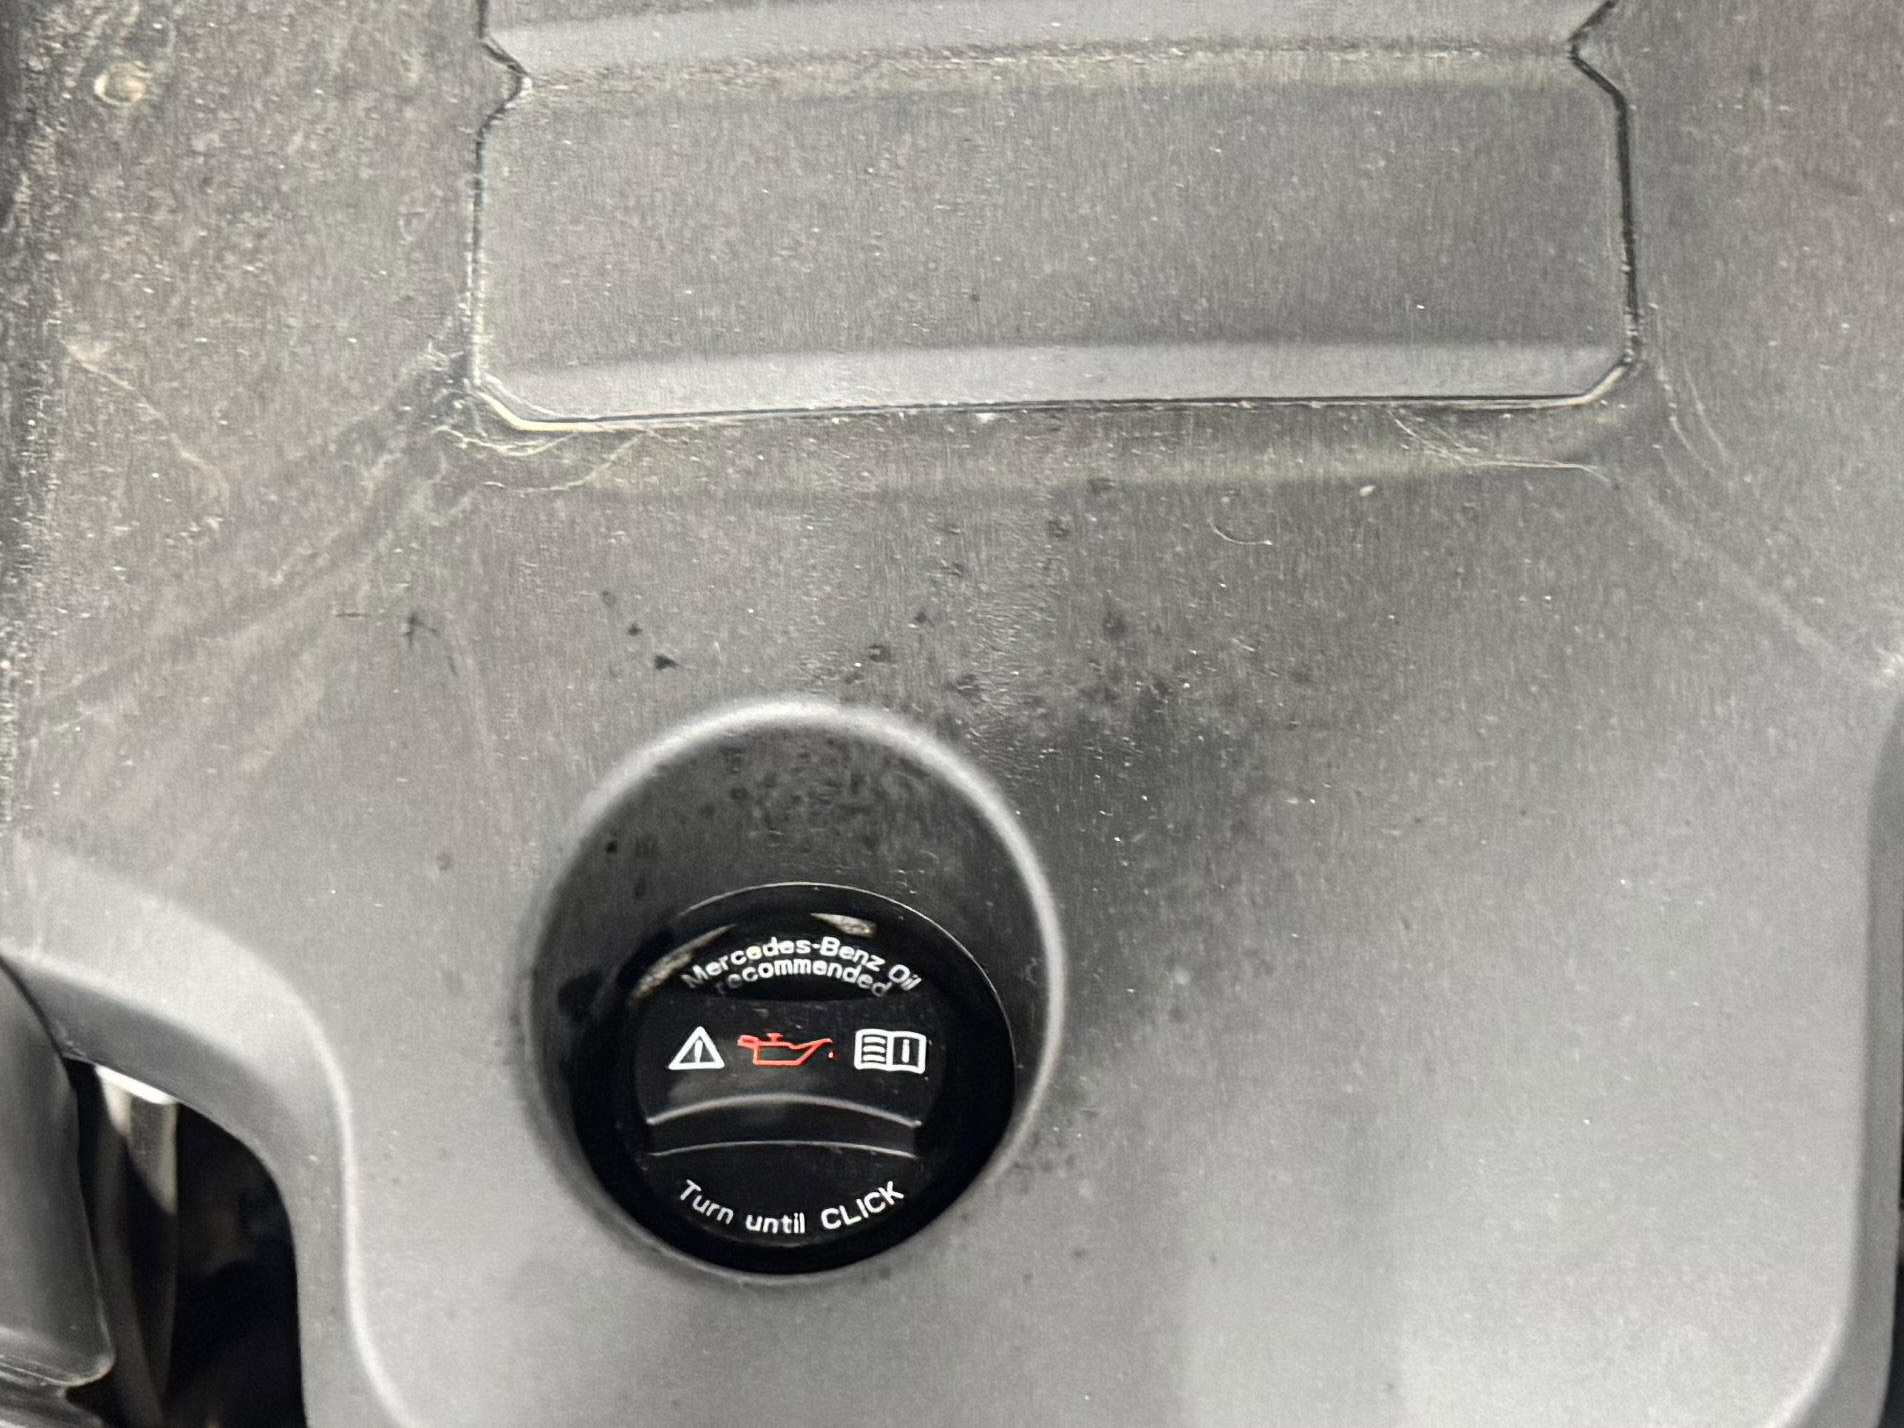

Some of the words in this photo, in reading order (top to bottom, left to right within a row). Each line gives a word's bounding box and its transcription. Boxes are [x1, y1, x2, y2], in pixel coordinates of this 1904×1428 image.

[681, 936, 885, 989] Mercedes-Benz
[888, 963, 922, 991] Oil
[715, 958, 892, 997] recommended
[679, 1179, 734, 1225] Turn
[745, 1212, 805, 1234] until
[820, 1180, 905, 1230] CLICK
